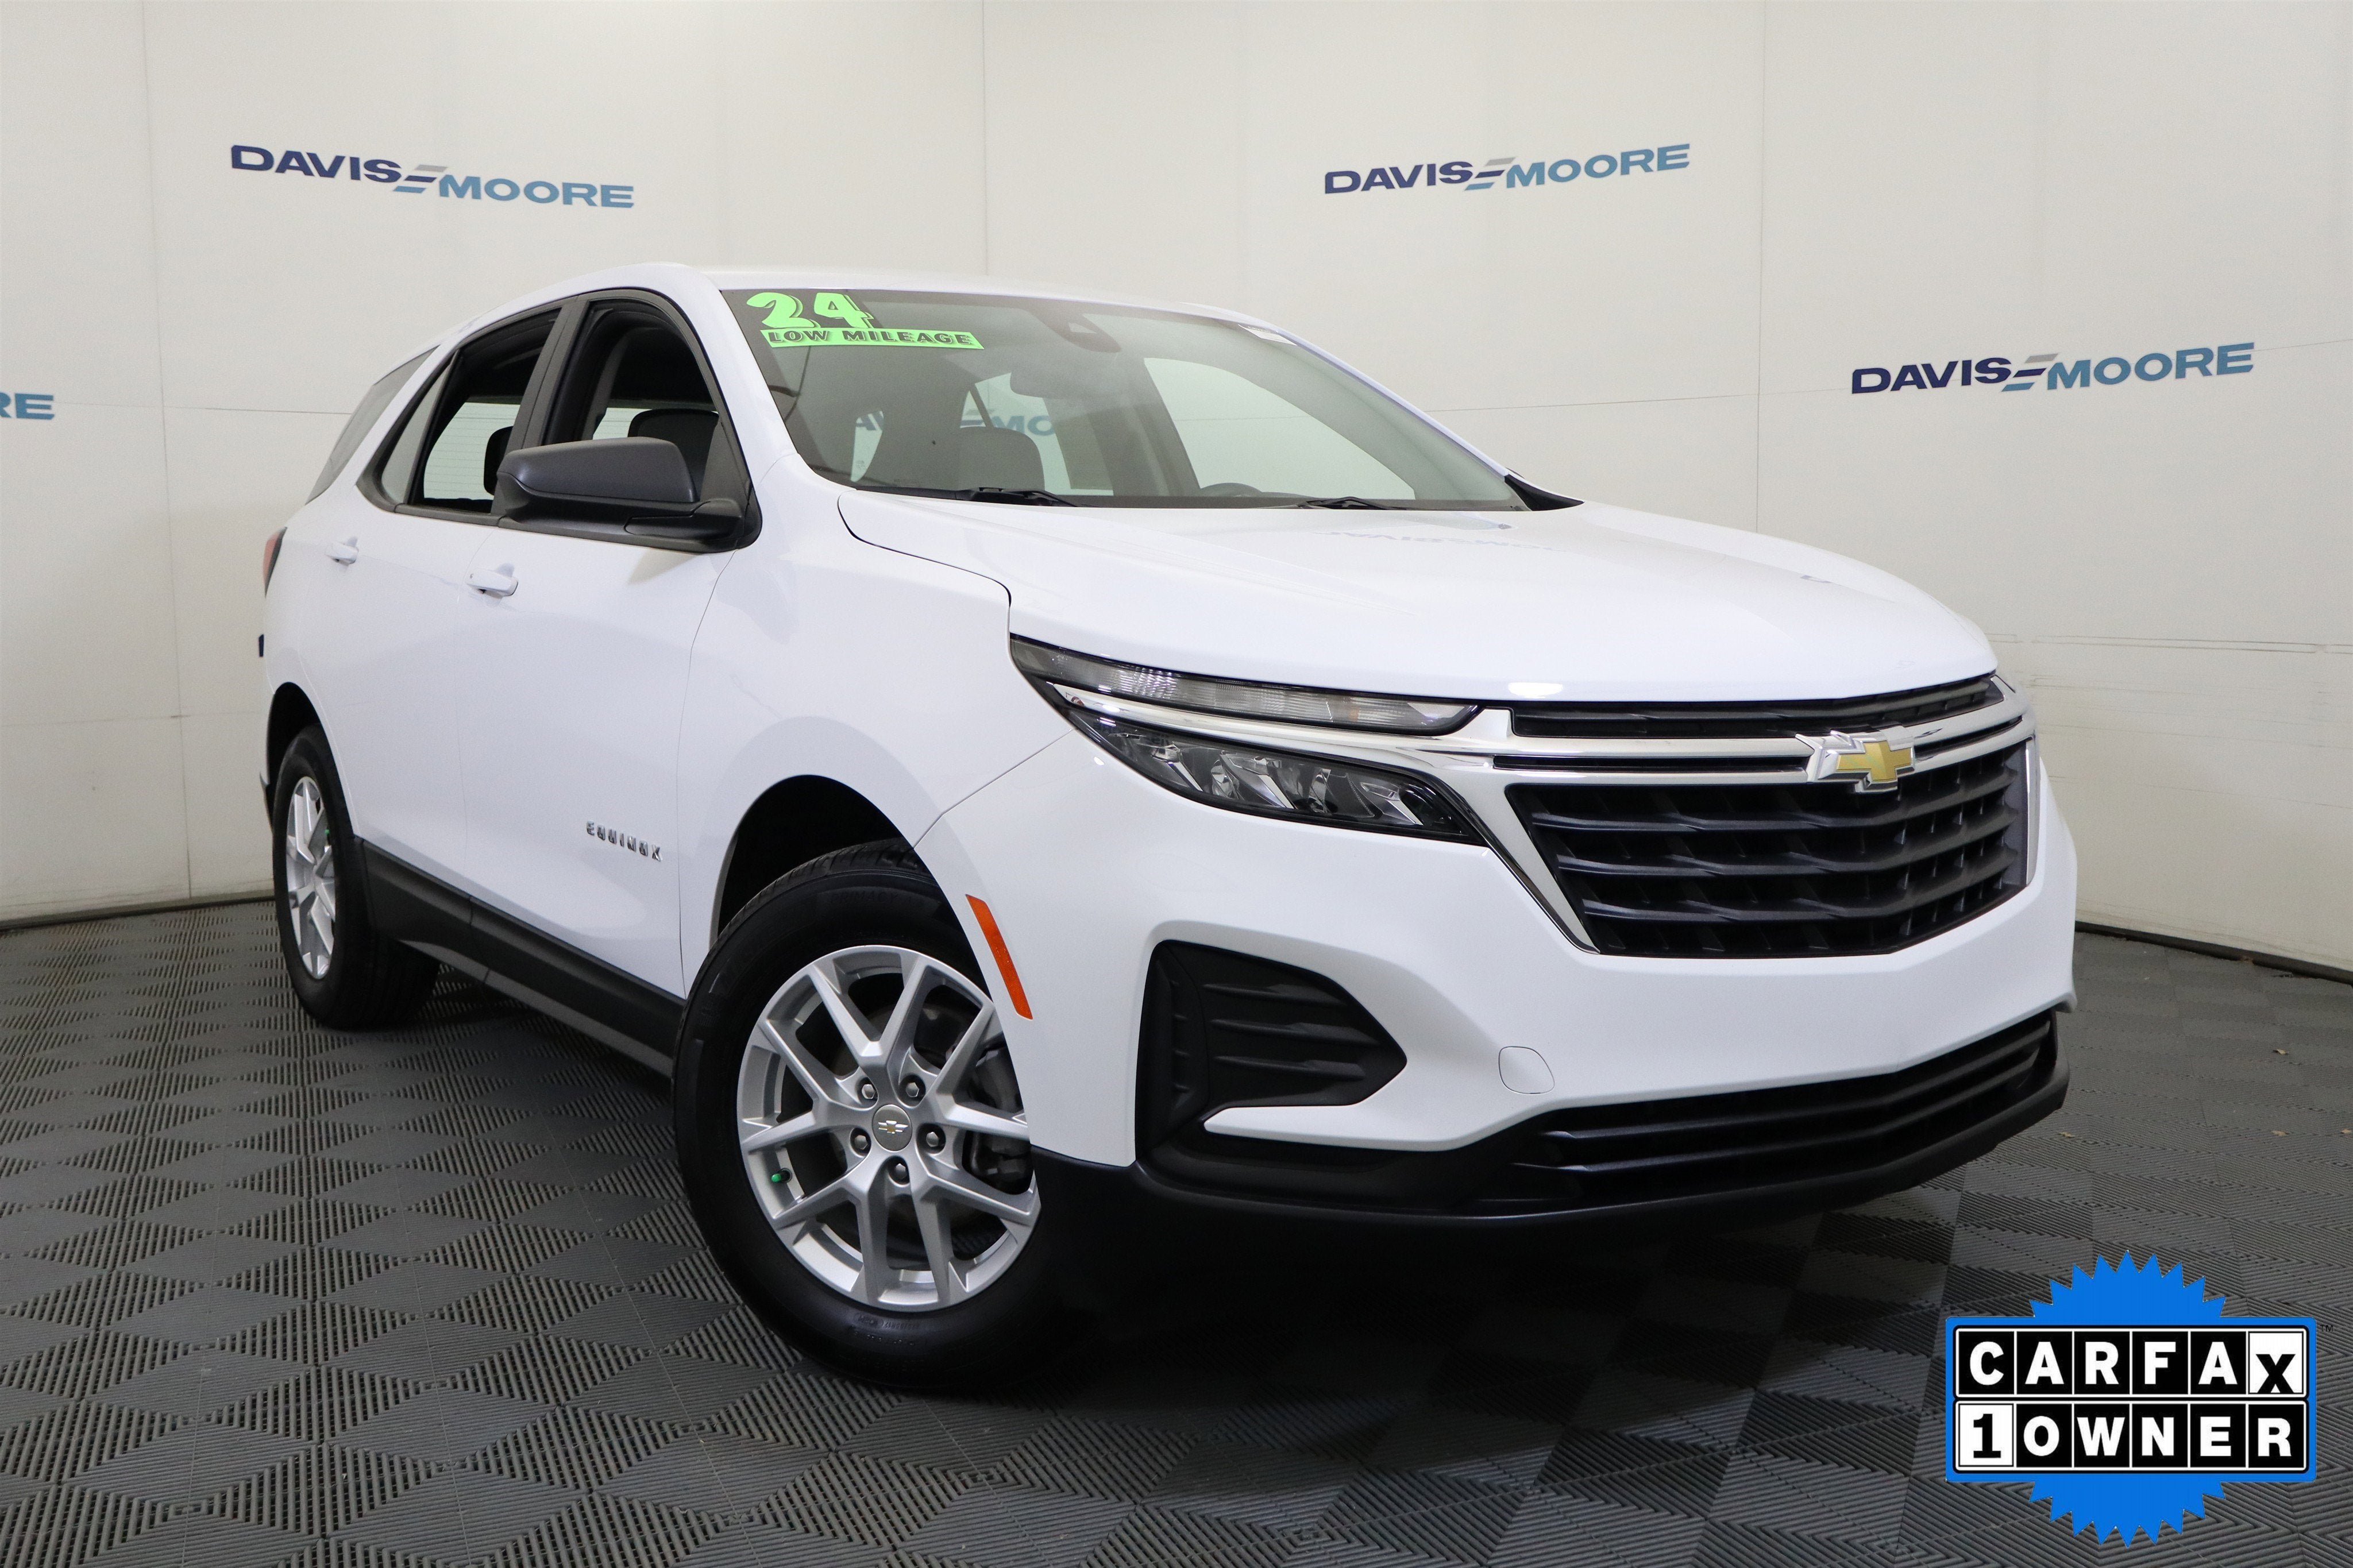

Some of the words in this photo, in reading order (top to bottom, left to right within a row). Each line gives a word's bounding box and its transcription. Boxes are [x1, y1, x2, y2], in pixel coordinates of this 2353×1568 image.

[231, 145, 402, 183] DAVIS
[438, 174, 634, 208] MOORE
[1325, 161, 1473, 194] DAVIS
[1506, 144, 1690, 188] MOORE
[747, 292, 874, 329] 24
[767, 330, 830, 343] LOW
[843, 330, 976, 345] MILEAGE
[1851, 357, 2011, 394] DAVIS
[2047, 342, 2255, 391] MOORE
[586, 820, 663, 862] EQUINOX
